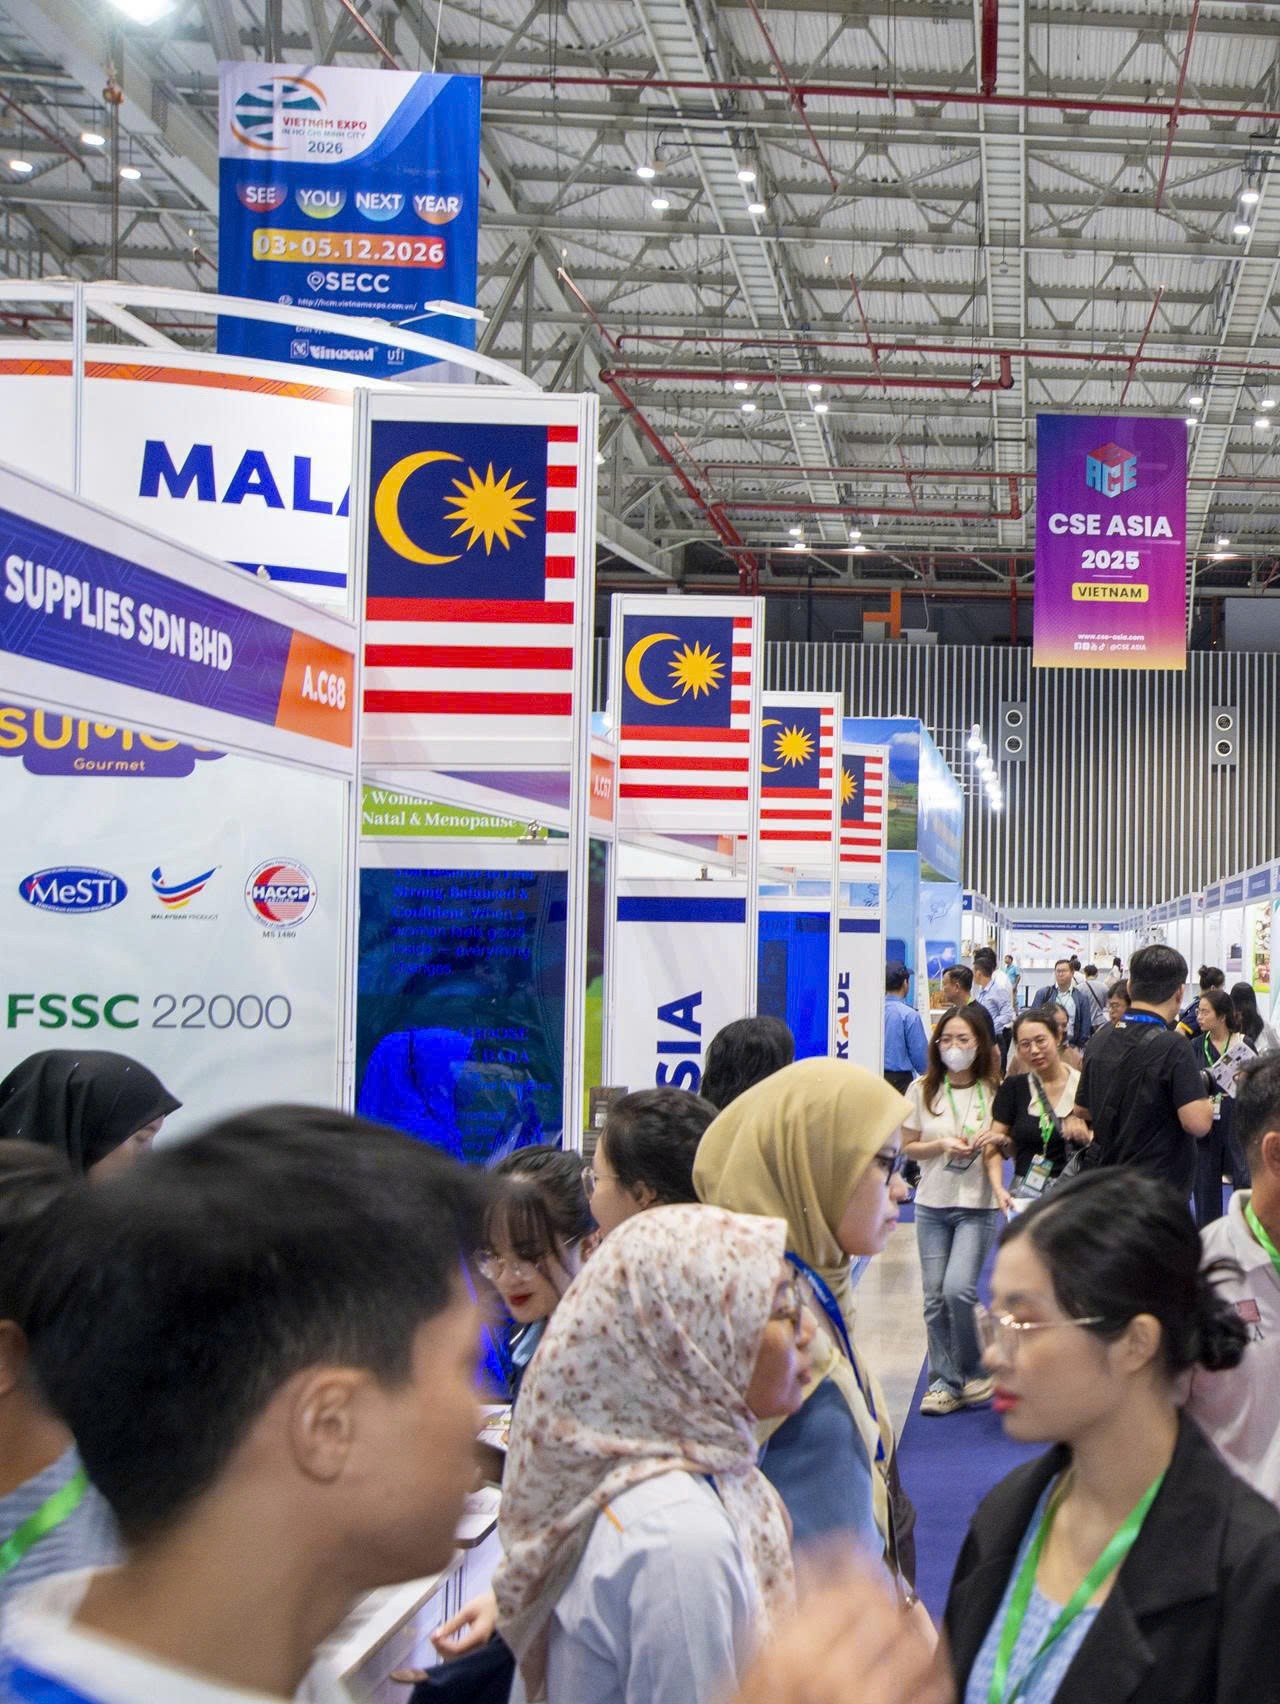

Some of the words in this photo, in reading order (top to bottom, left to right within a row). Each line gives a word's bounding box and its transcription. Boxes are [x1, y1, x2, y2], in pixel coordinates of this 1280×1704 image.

[282, 116, 334, 129] VIETNAM
[336, 119, 368, 131] EXPO
[346, 130, 366, 139] CITY
[307, 141, 343, 155] 2026
[246, 185, 276, 204] SEE
[300, 188, 341, 207] YOU
[355, 191, 402, 211] NEXT
[413, 195, 459, 214] YEAR
[325, 272, 391, 294] SECC
[1048, 513, 1101, 536] CSE
[1105, 514, 1173, 538] ASIA
[1081, 549, 1140, 570] 2025
[1078, 586, 1142, 599] VIETNAM
[5, 555, 136, 640] SUPPLIES
[138, 602, 186, 659] SDN
[189, 618, 234, 672] BHD
[301, 664, 347, 711] A.C68
[73, 757, 146, 772] Gourmet
[409, 812, 422, 826] &
[29, 878, 118, 905] MeSTI
[253, 886, 309, 900] HACCP
[7, 992, 140, 1030] FSSC
[152, 993, 293, 1030] 22000
[655, 990, 703, 1093] SIA
